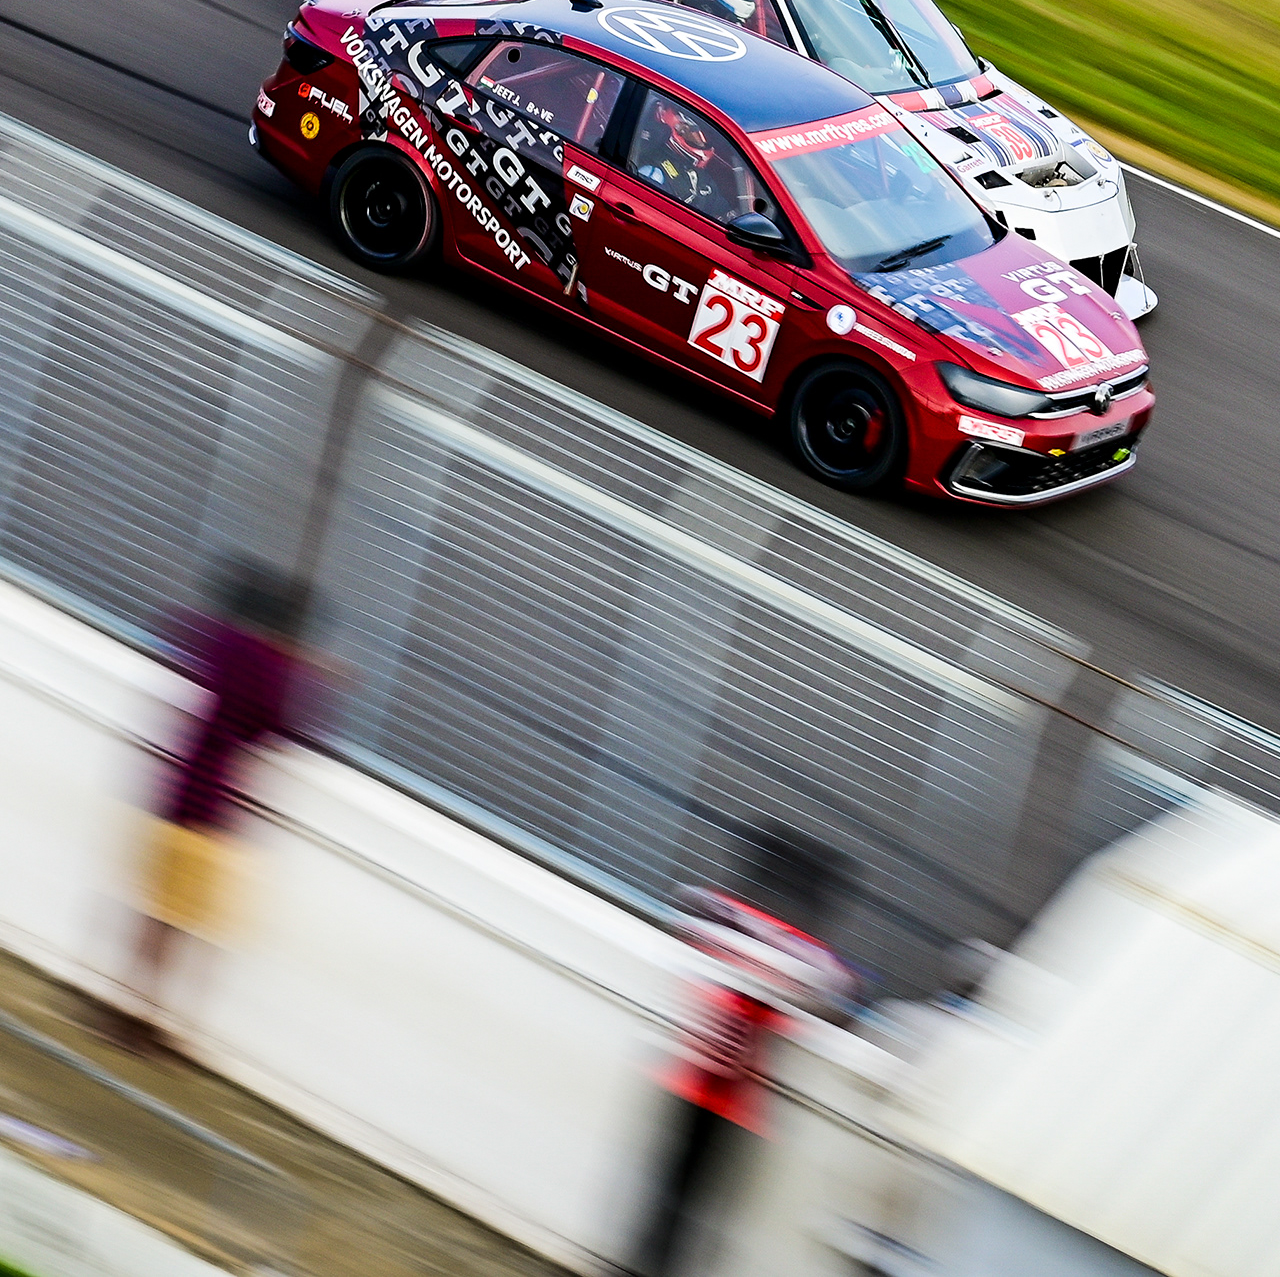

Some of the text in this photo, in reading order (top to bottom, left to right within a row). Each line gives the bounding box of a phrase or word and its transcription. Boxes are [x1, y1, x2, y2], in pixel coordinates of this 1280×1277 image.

[339, 25, 532, 271] VOLKSWAGEN MOTORSPORT
[754, 110, 893, 155] www.mrftyres.com
[990, 126, 1033, 160] 39
[956, 158, 986, 174] Garrett
[604, 246, 699, 305] VIRTUS GT
[707, 269, 787, 317] MRF
[1000, 261, 1065, 283] VIRTUS
[1019, 270, 1093, 303] GT
[693, 294, 768, 373] 23
[1032, 316, 1104, 367] 23
